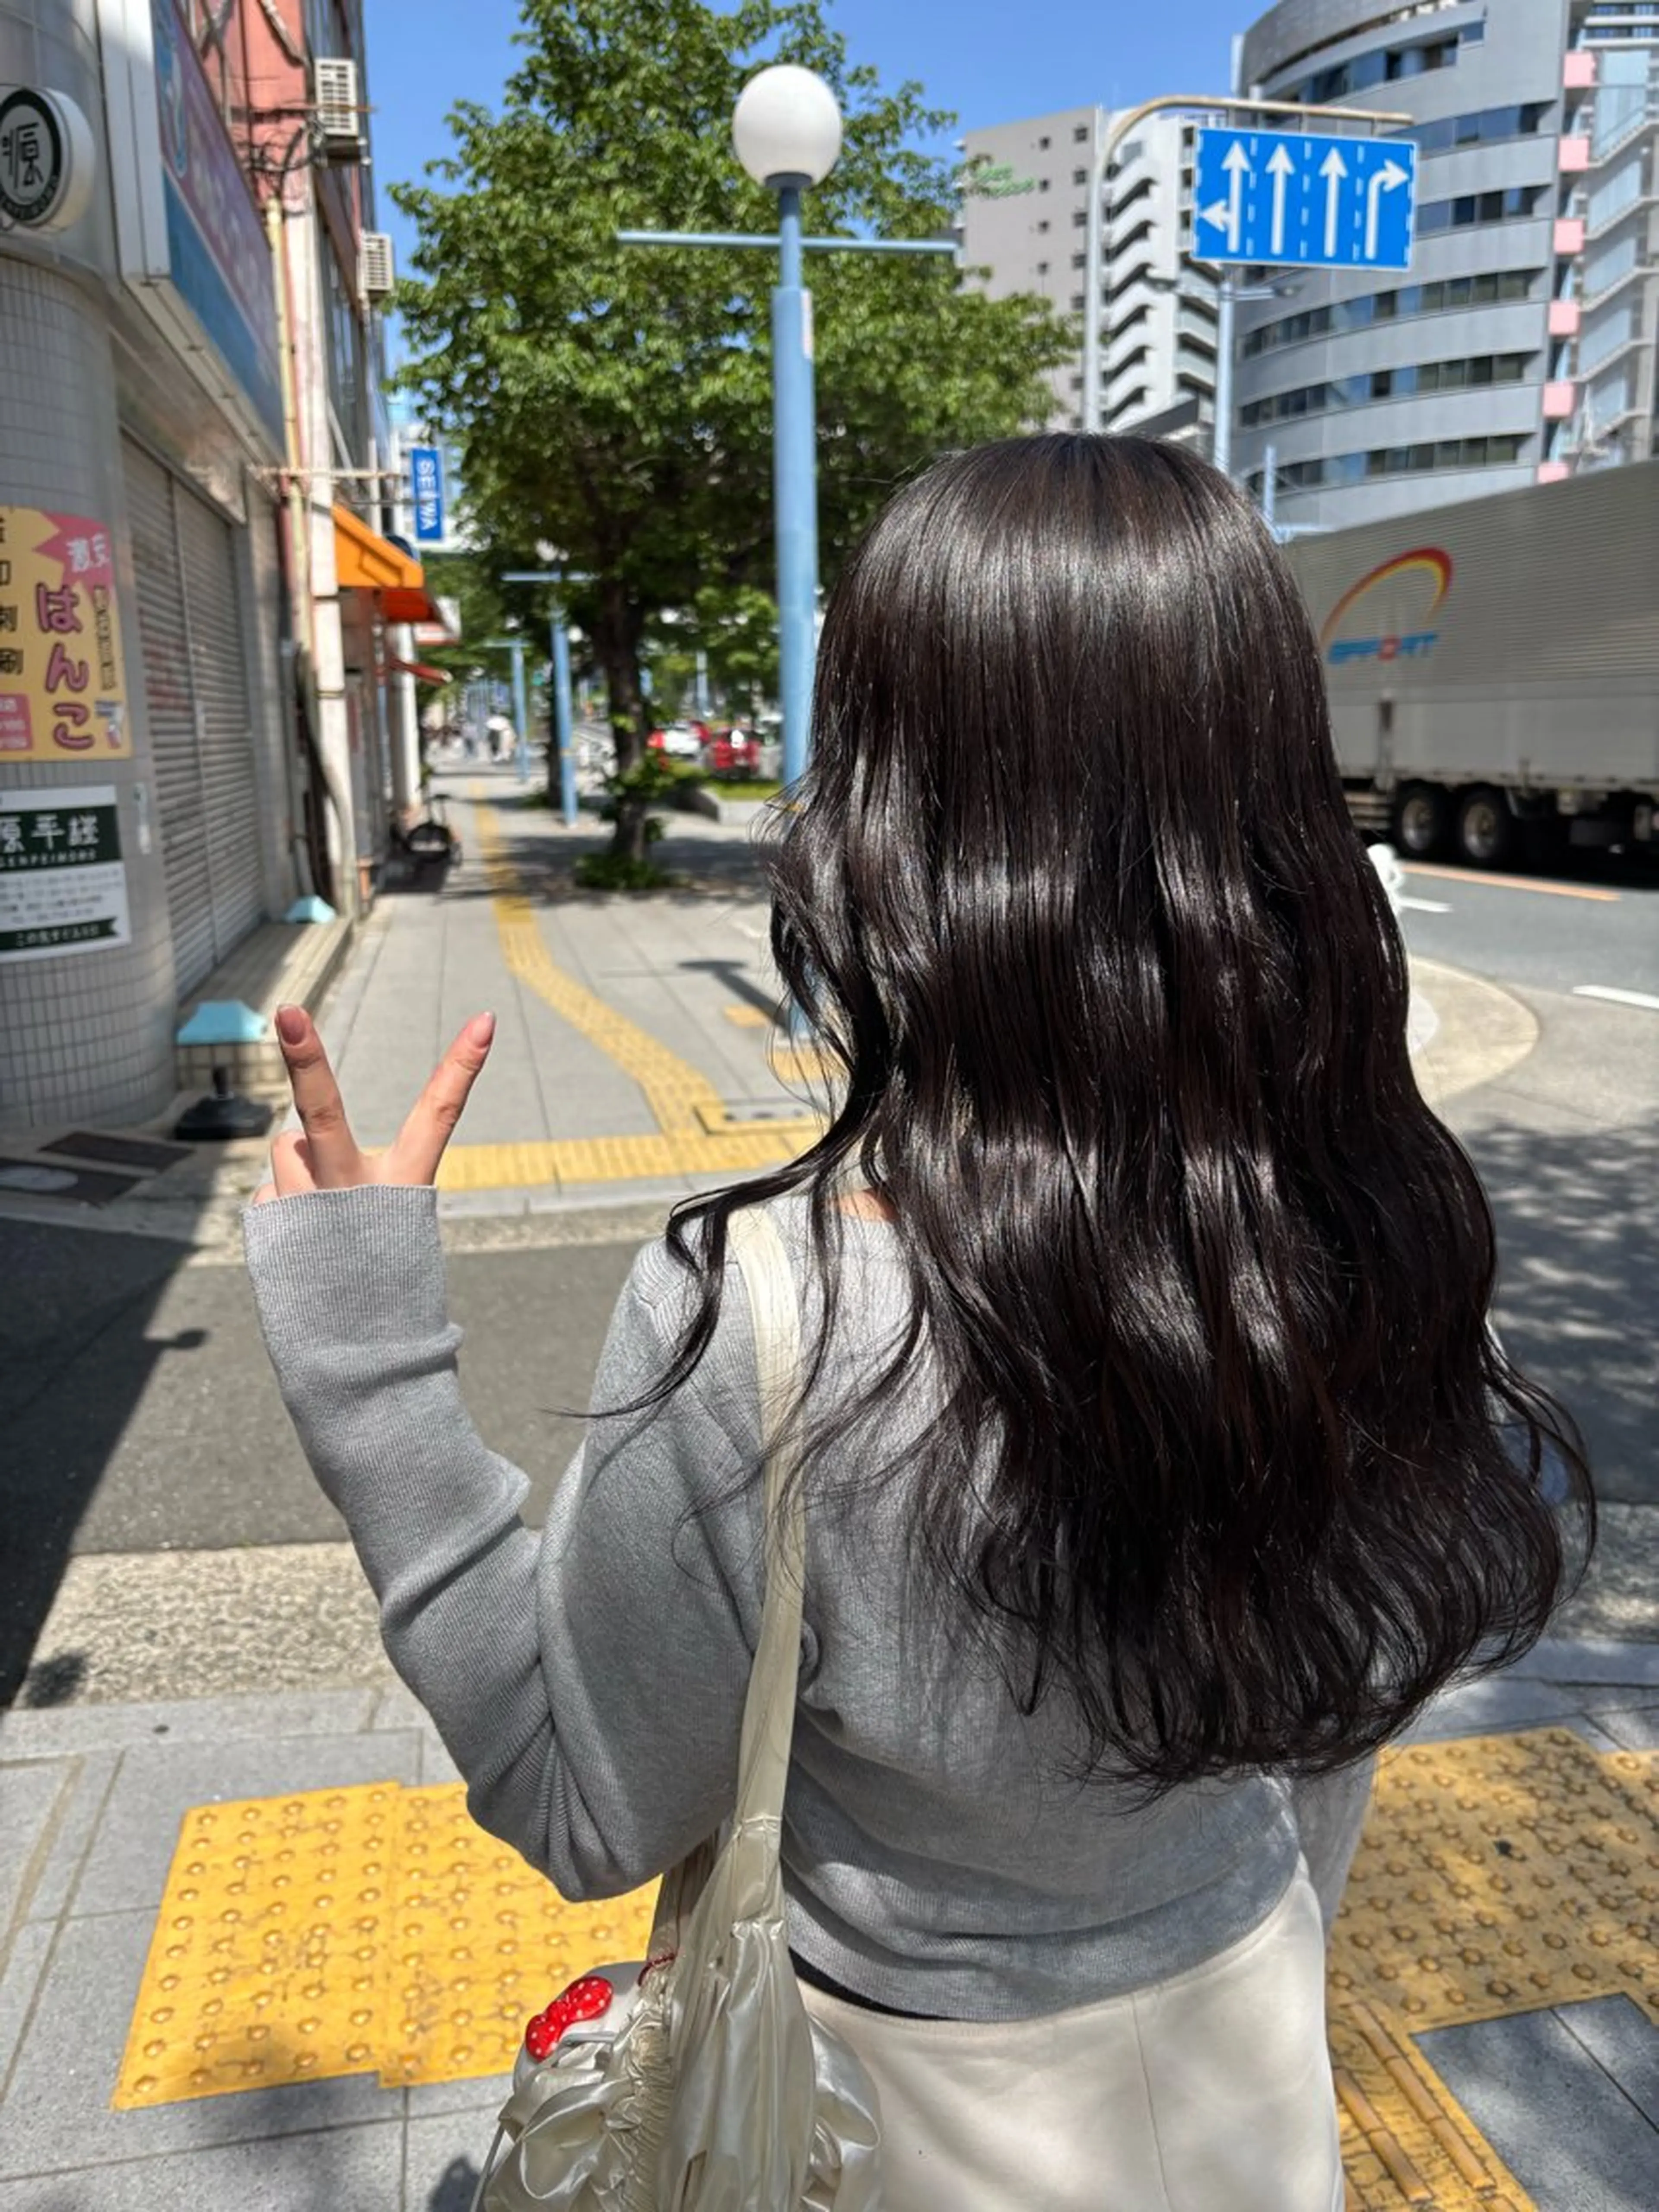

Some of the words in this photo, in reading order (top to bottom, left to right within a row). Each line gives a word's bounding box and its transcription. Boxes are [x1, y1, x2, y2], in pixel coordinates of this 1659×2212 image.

[416, 458, 440, 531] SEIWA
[35, 582, 95, 750] はんこ
